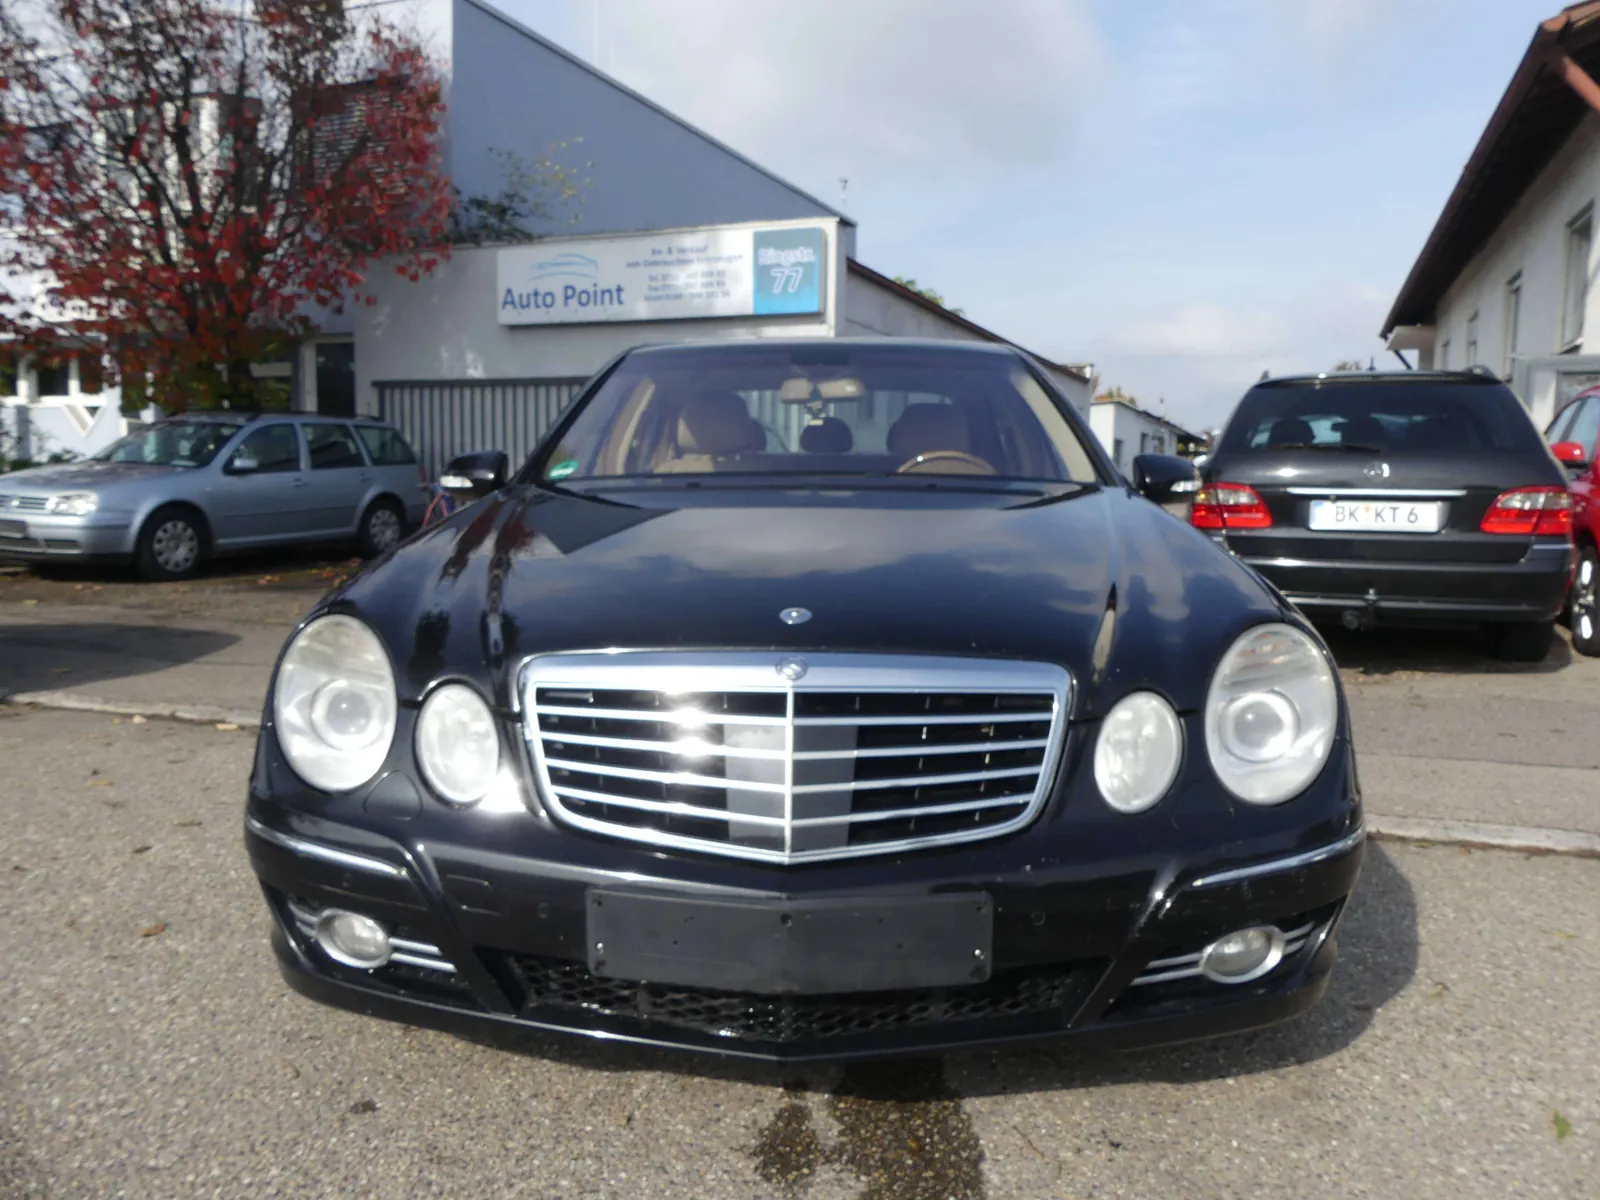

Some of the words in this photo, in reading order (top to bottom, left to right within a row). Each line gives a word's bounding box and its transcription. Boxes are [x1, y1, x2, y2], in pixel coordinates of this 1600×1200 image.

[770, 266, 803, 294] 77
[502, 287, 556, 310] Auto
[564, 282, 625, 308] Point
[1335, 506, 1360, 522] BK
[1374, 506, 1400, 523] KT
